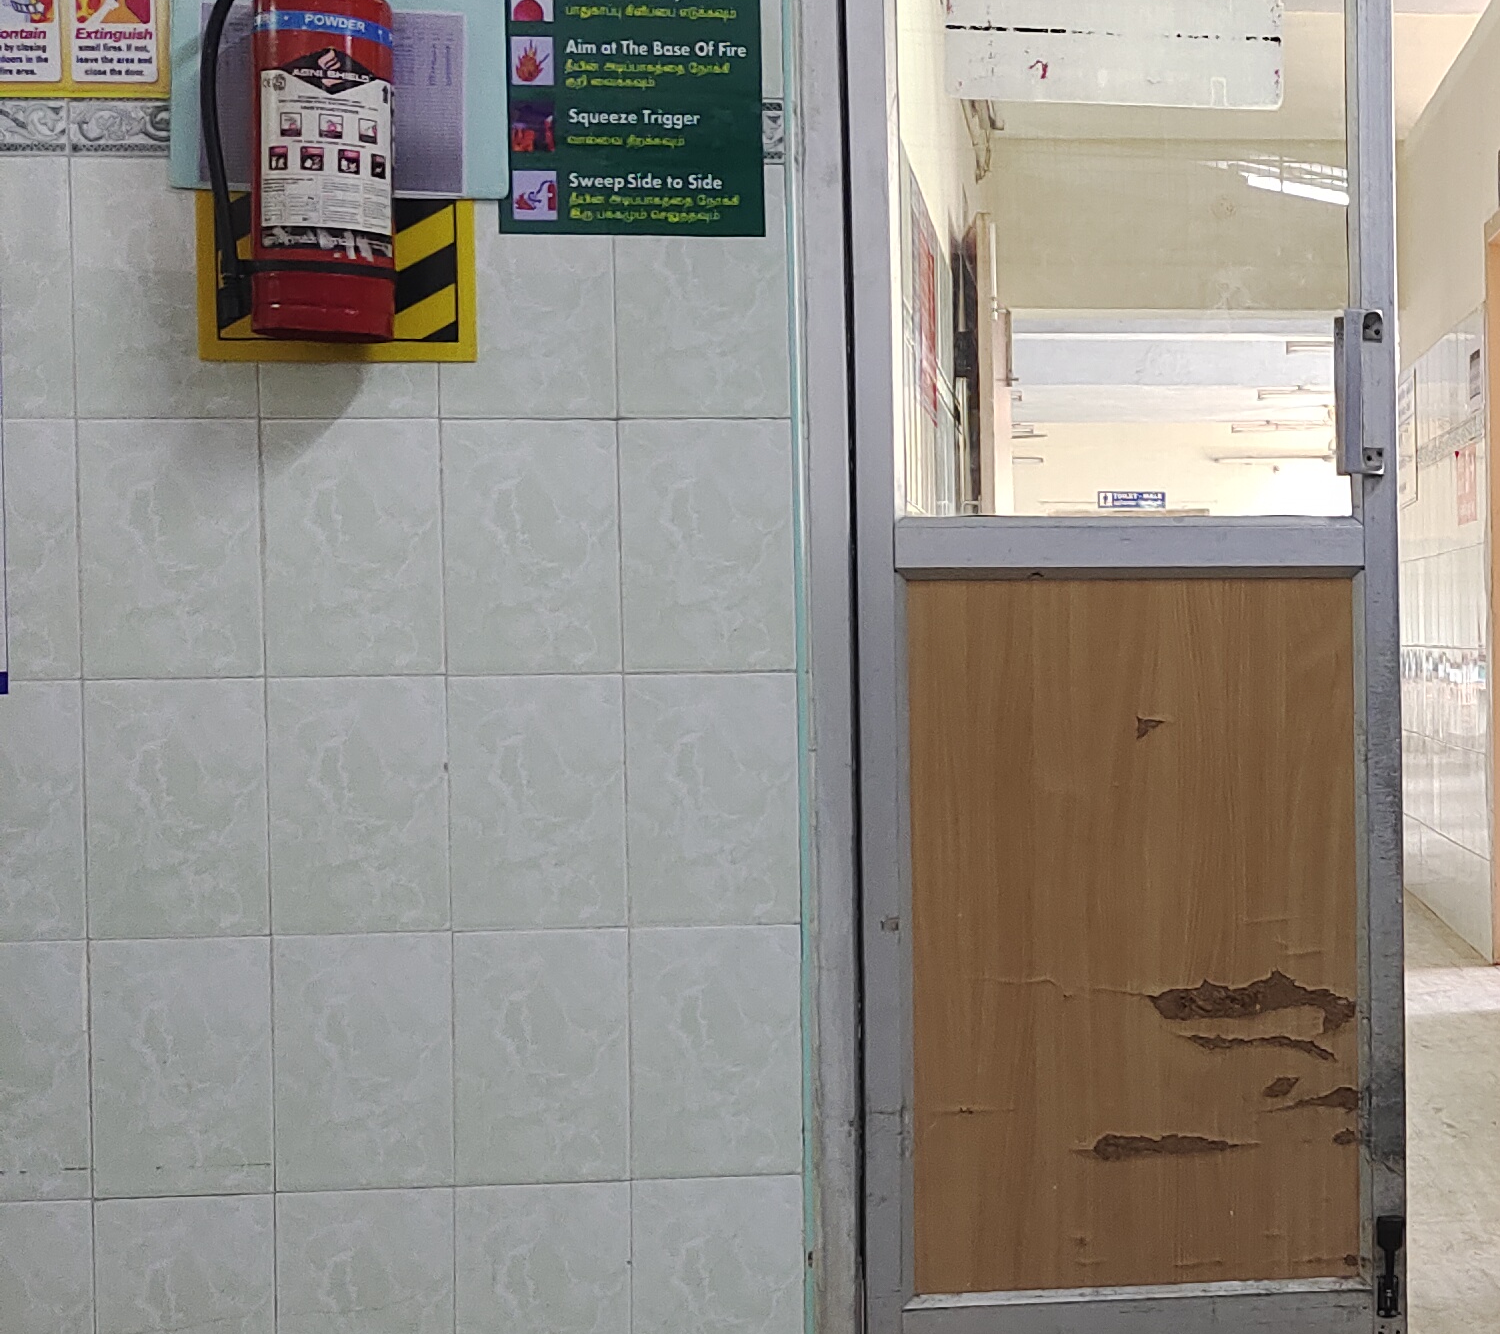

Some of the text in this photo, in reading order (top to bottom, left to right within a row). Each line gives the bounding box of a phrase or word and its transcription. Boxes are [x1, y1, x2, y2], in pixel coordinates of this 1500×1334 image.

[304, 14, 365, 32] POWDER
[76, 28, 152, 42] Extinguish
[566, 39, 746, 57] Aim at The Base Of Fire
[569, 109, 700, 129] Squeeze Trigger
[569, 173, 722, 191] Sweep Side to Side
